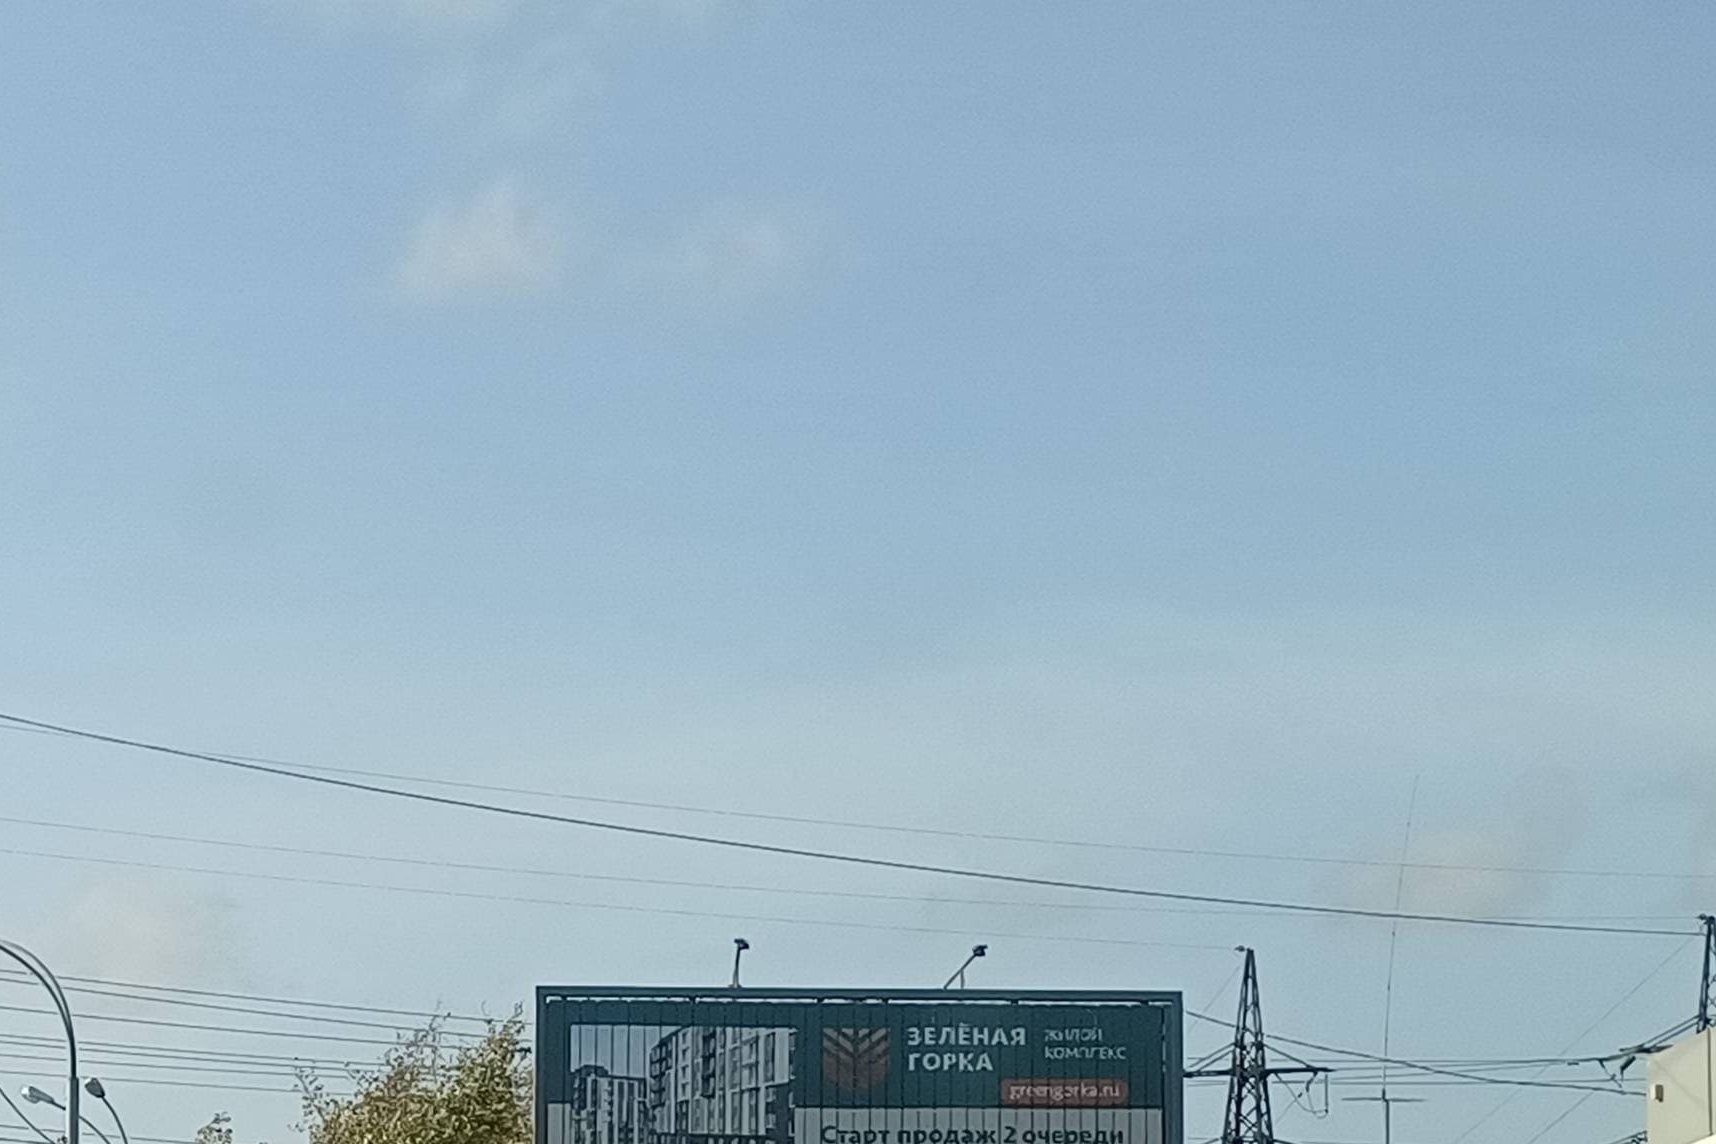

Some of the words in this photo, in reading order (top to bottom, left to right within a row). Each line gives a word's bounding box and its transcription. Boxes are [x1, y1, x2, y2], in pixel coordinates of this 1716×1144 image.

[907, 1022, 1026, 1046] ЗЕЛЁНАЯ
[907, 1052, 993, 1072] ГОРКА
[1003, 1126, 1017, 1144] 2
